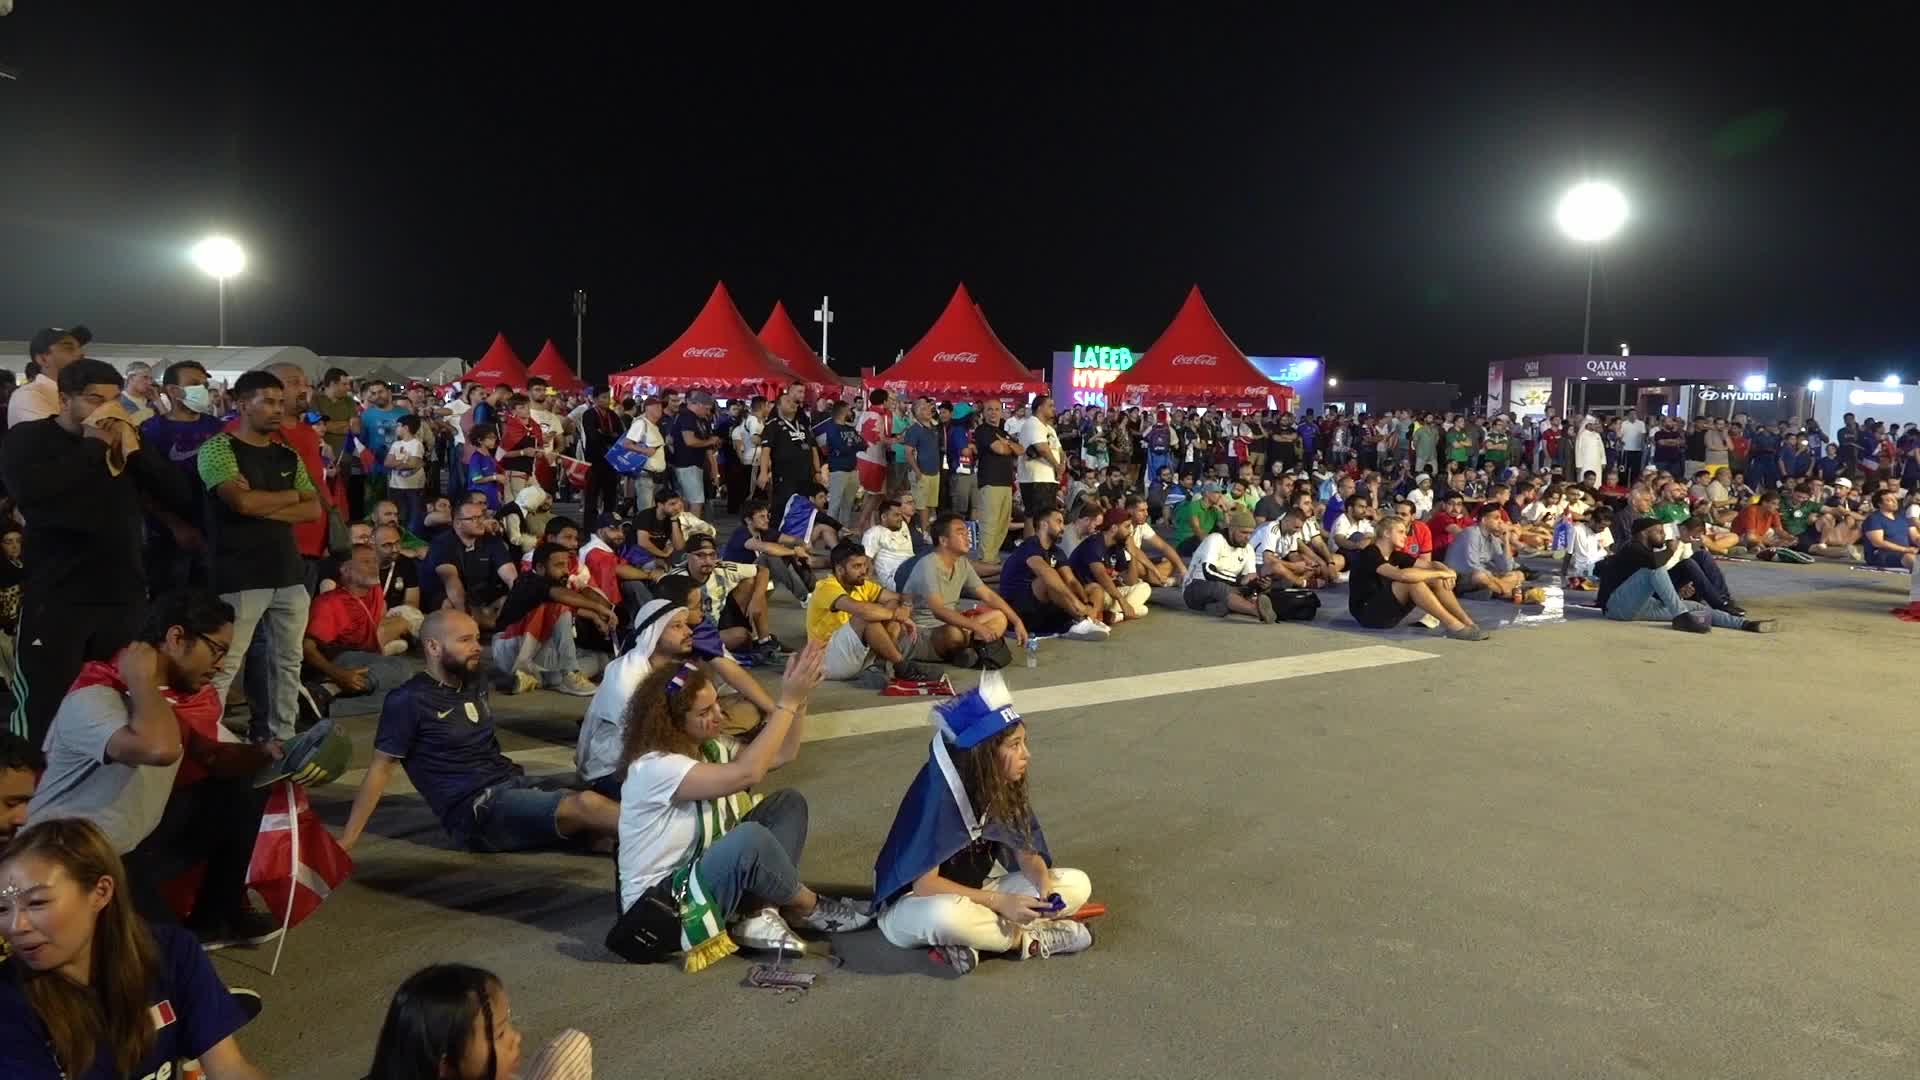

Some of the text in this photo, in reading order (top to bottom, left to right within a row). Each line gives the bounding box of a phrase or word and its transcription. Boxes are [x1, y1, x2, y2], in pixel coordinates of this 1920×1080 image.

[1074, 345, 1132, 370] LA'EEB
[1587, 360, 1627, 372] QATAR
[1720, 391, 1774, 401] HYUNDAI
